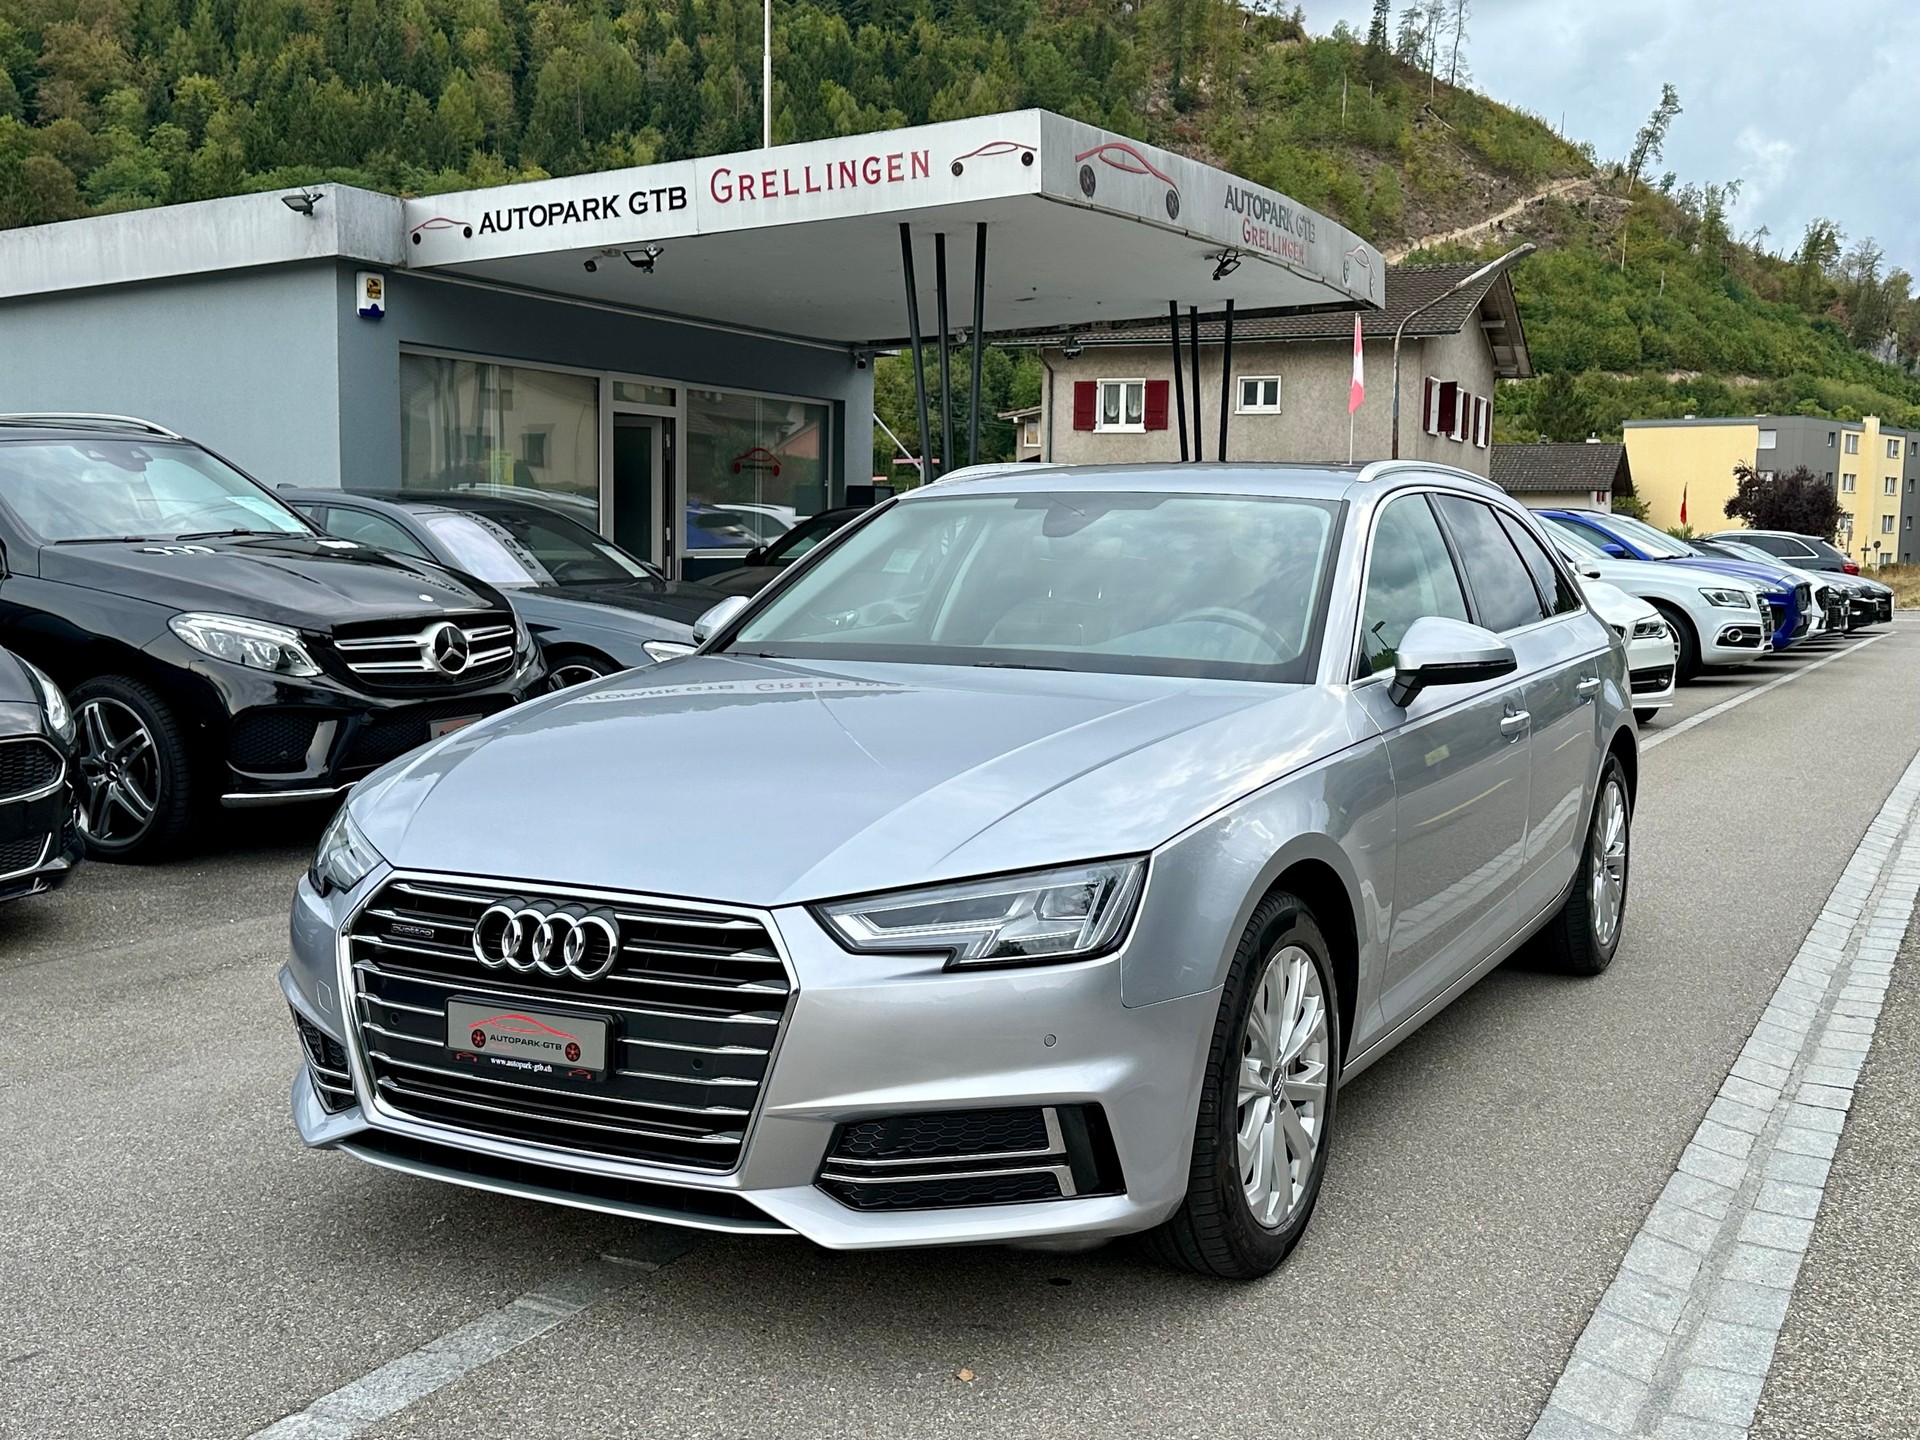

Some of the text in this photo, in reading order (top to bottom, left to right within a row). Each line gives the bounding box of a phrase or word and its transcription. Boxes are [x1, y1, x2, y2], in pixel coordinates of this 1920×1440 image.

[478, 150, 930, 235] AUTOPARK GTB GRELLINGEN
[1224, 185, 1316, 244] AUTOPARK GTB
[1242, 217, 1305, 265] GRELLINGEN
[489, 1034, 562, 1051] AUTOPARK-GTB
[490, 1057, 553, 1073] www.autopark-gtb.ch
